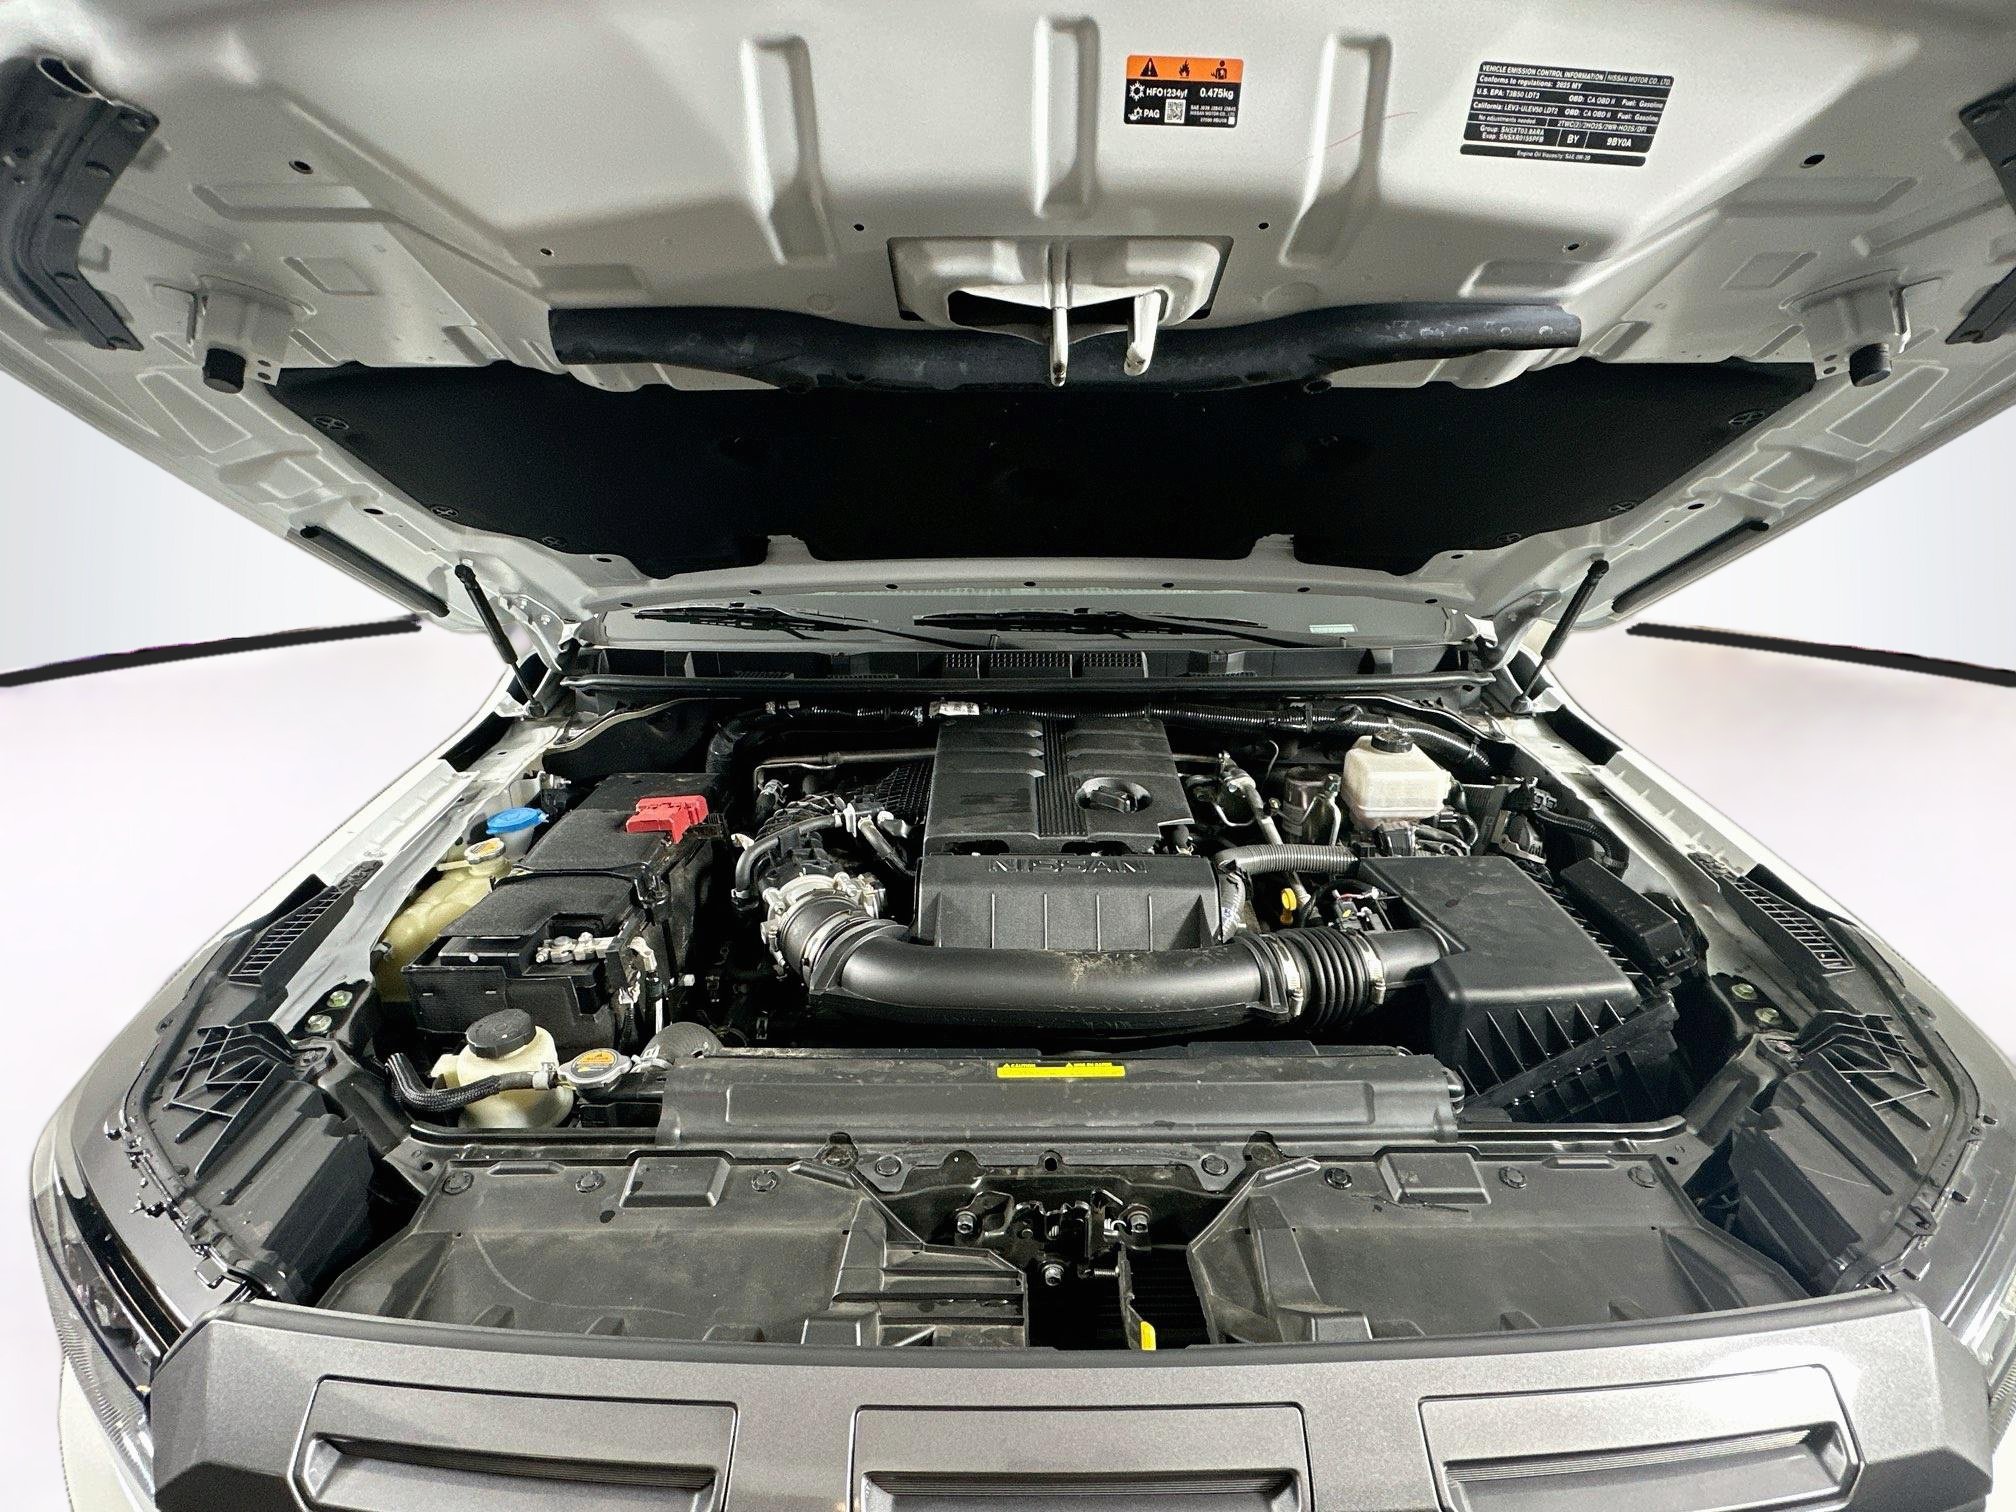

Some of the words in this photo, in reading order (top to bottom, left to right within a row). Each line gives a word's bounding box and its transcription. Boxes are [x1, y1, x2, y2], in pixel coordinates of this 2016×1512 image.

[1482, 64, 1506, 73] VEHICLE
[1508, 66, 1536, 75] EMISSION
[1536, 68, 1562, 77] CONTROL
[1564, 71, 1604, 80] INFORMATION
[1480, 75, 1508, 84] Conforms
[1518, 79, 1553, 87] regulations:
[1608, 74, 1628, 82] NISSAN
[1629, 76, 1648, 84] MOTOR
[1146, 87, 1188, 98] HFO1234yf
[1200, 88, 1234, 100] 0.475kg
[1144, 109, 1160, 118] PAG
[1566, 134, 1579, 144] BY
[988, 858, 1148, 872] NISSAN
